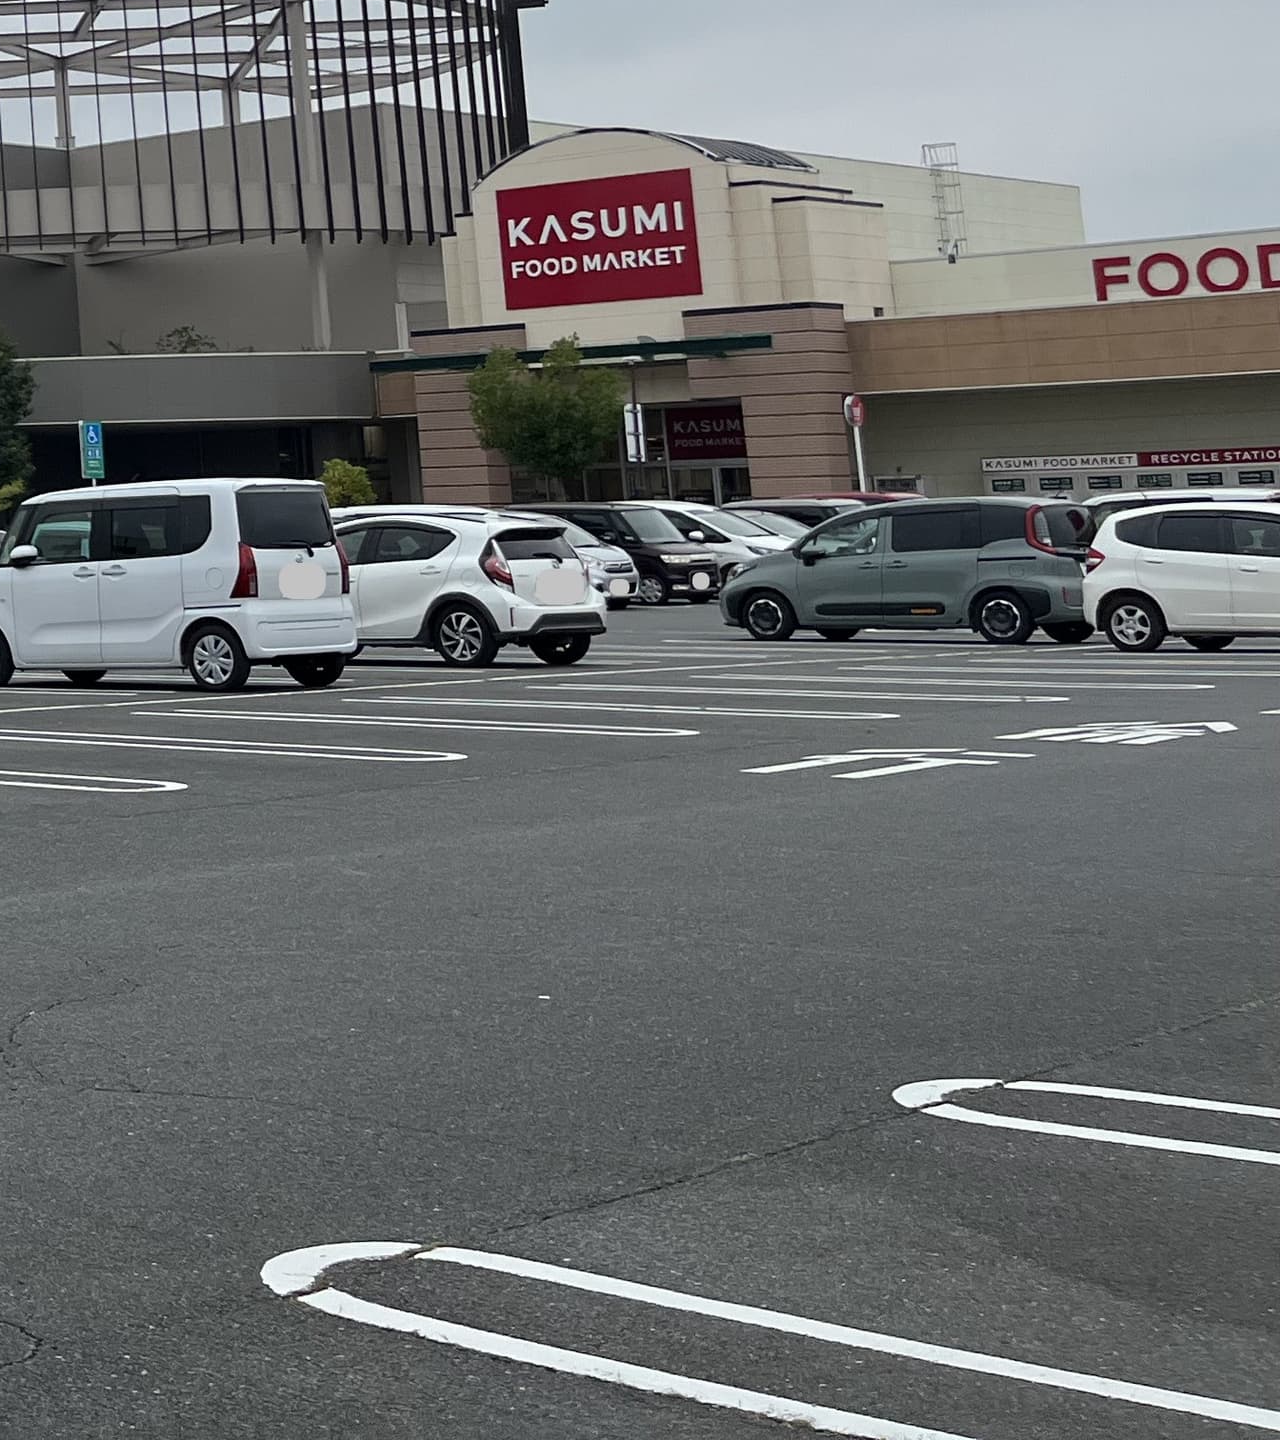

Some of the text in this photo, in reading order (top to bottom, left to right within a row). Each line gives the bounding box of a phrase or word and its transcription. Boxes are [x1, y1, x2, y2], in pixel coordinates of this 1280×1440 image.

[507, 201, 684, 247] KASUMI
[511, 246, 686, 279] FOOD MARKET
[673, 418, 742, 434] KASUM
[705, 436, 743, 447] MARKE
[984, 456, 1134, 469] KASUMI FOOD MARKET
[1150, 449, 1280, 464] RECYCLE STATIO
